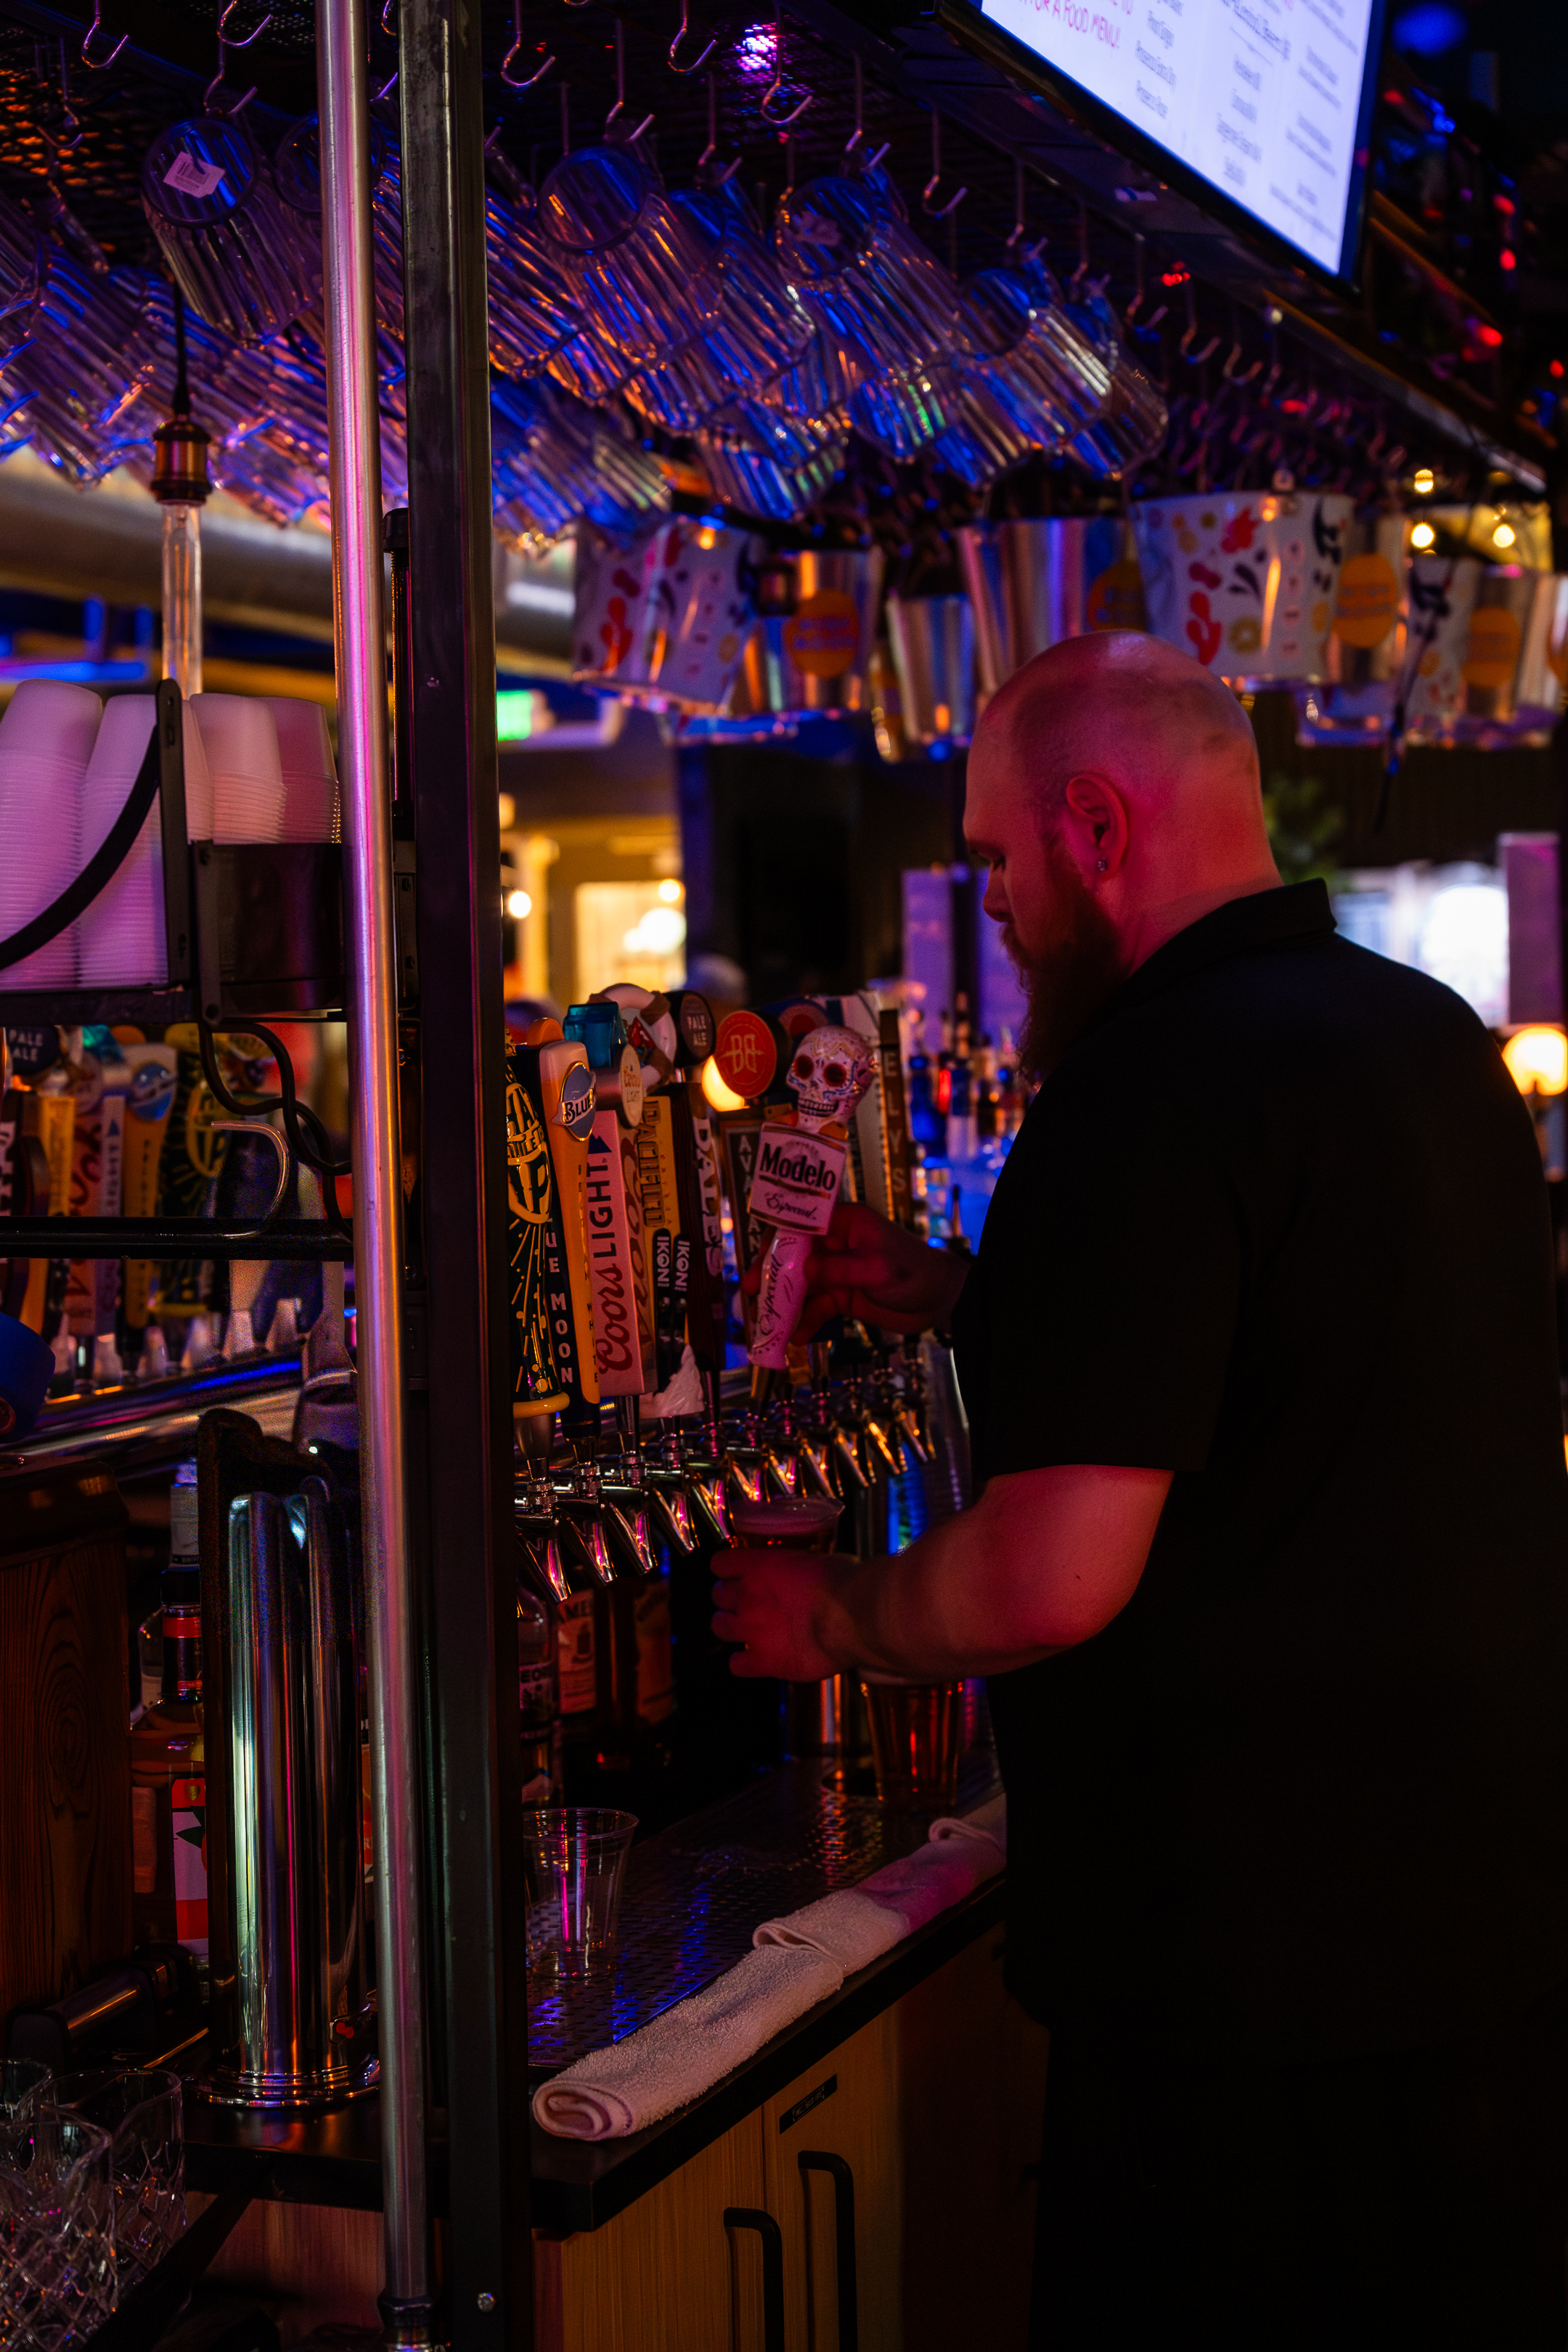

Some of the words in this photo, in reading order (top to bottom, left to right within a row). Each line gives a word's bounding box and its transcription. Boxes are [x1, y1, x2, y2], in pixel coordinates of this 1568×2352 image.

[8, 1029, 44, 1047] PALE
[12, 1046, 38, 1063] ALE
[759, 1143, 836, 1190] Modelo
[586, 1161, 617, 1258] LIGHT
[550, 1292, 573, 1384] MOON
[594, 1263, 634, 1374] Coors
